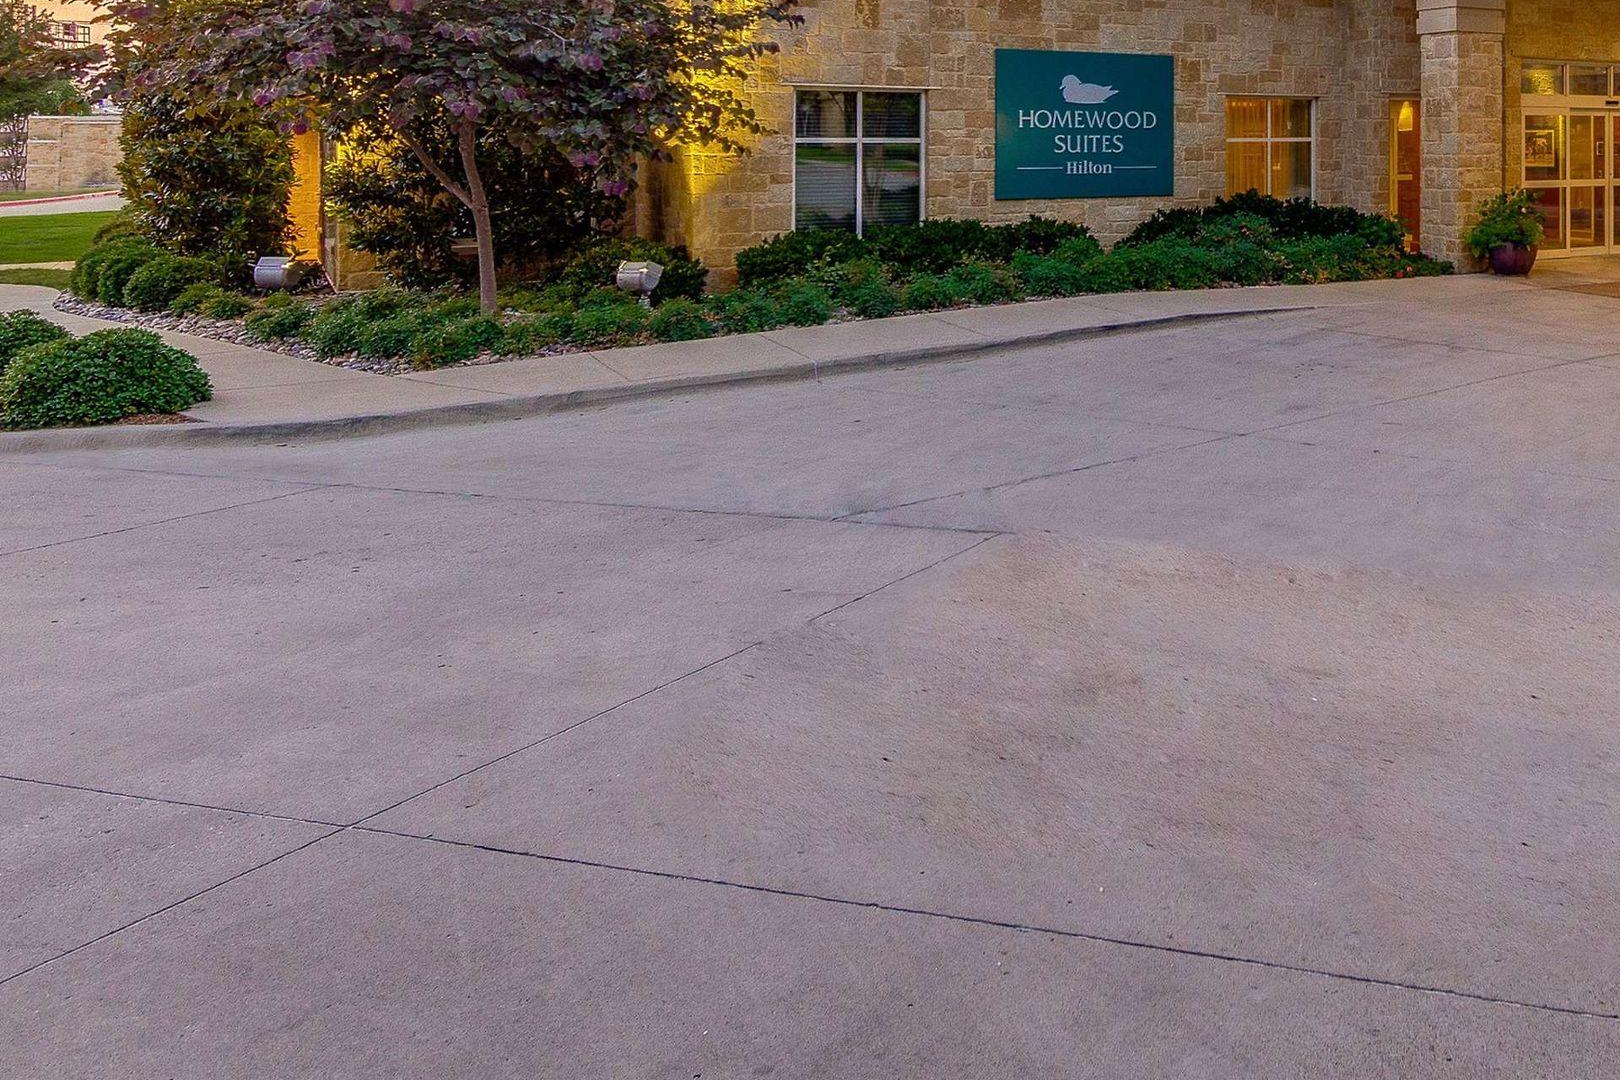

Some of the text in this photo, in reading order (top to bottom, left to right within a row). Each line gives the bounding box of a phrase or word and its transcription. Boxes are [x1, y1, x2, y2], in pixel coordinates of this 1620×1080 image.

[1018, 109, 1157, 130] HOMEWOOD
[1054, 134, 1124, 154] SUITES
[1066, 160, 1112, 175] Hilton
